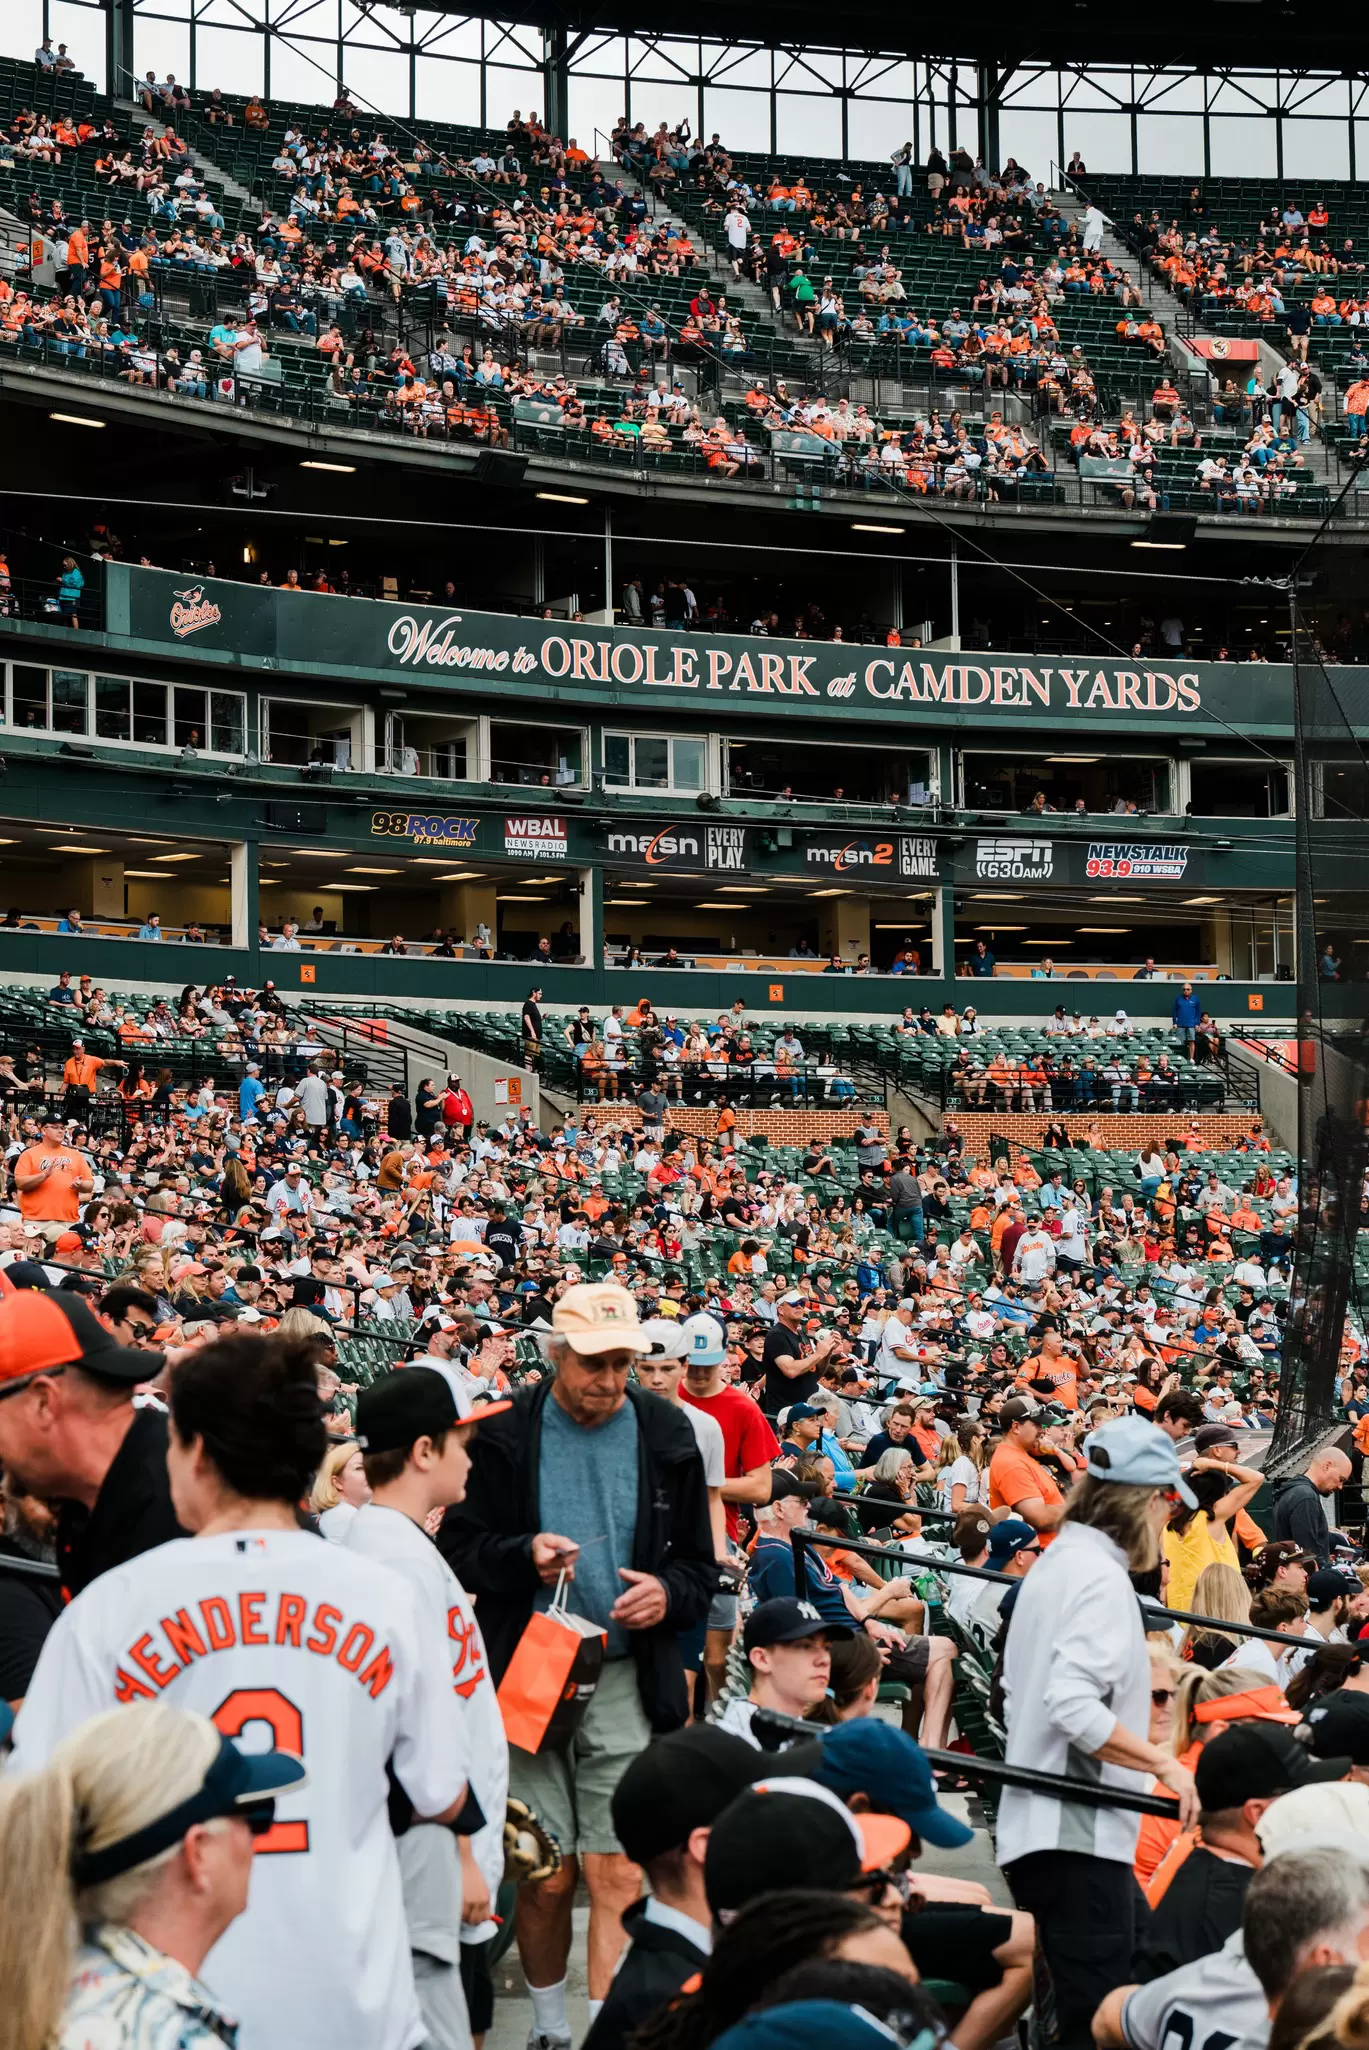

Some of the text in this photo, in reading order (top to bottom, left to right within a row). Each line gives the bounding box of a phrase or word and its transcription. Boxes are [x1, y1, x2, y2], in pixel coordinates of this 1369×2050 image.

[88, 253, 95, 263] 5
[170, 599, 221, 632] Orioles
[388, 616, 1200, 712] Welcome to ORIOLE PARK at CAMDEN YARDS
[507, 818, 565, 837] WBAL
[707, 827, 745, 847] EVERY
[413, 837, 472, 848] 97.9 baltimore
[507, 839, 565, 851] NEWSRADIO
[608, 831, 698, 858] masn
[902, 838, 938, 856] EVERY
[976, 839, 1053, 862] ESPN
[507, 849, 522, 857] 1090
[707, 847, 745, 869] PLAY.
[1088, 844, 1188, 861] NEWSTALK
[902, 857, 940, 877] GAME.
[1086, 859, 1181, 878] 93.9 910 WSBA
[694, 1335, 708, 1349] D
[114, 1591, 394, 1704] HENDERSON
[210, 1687, 309, 1854] 2
